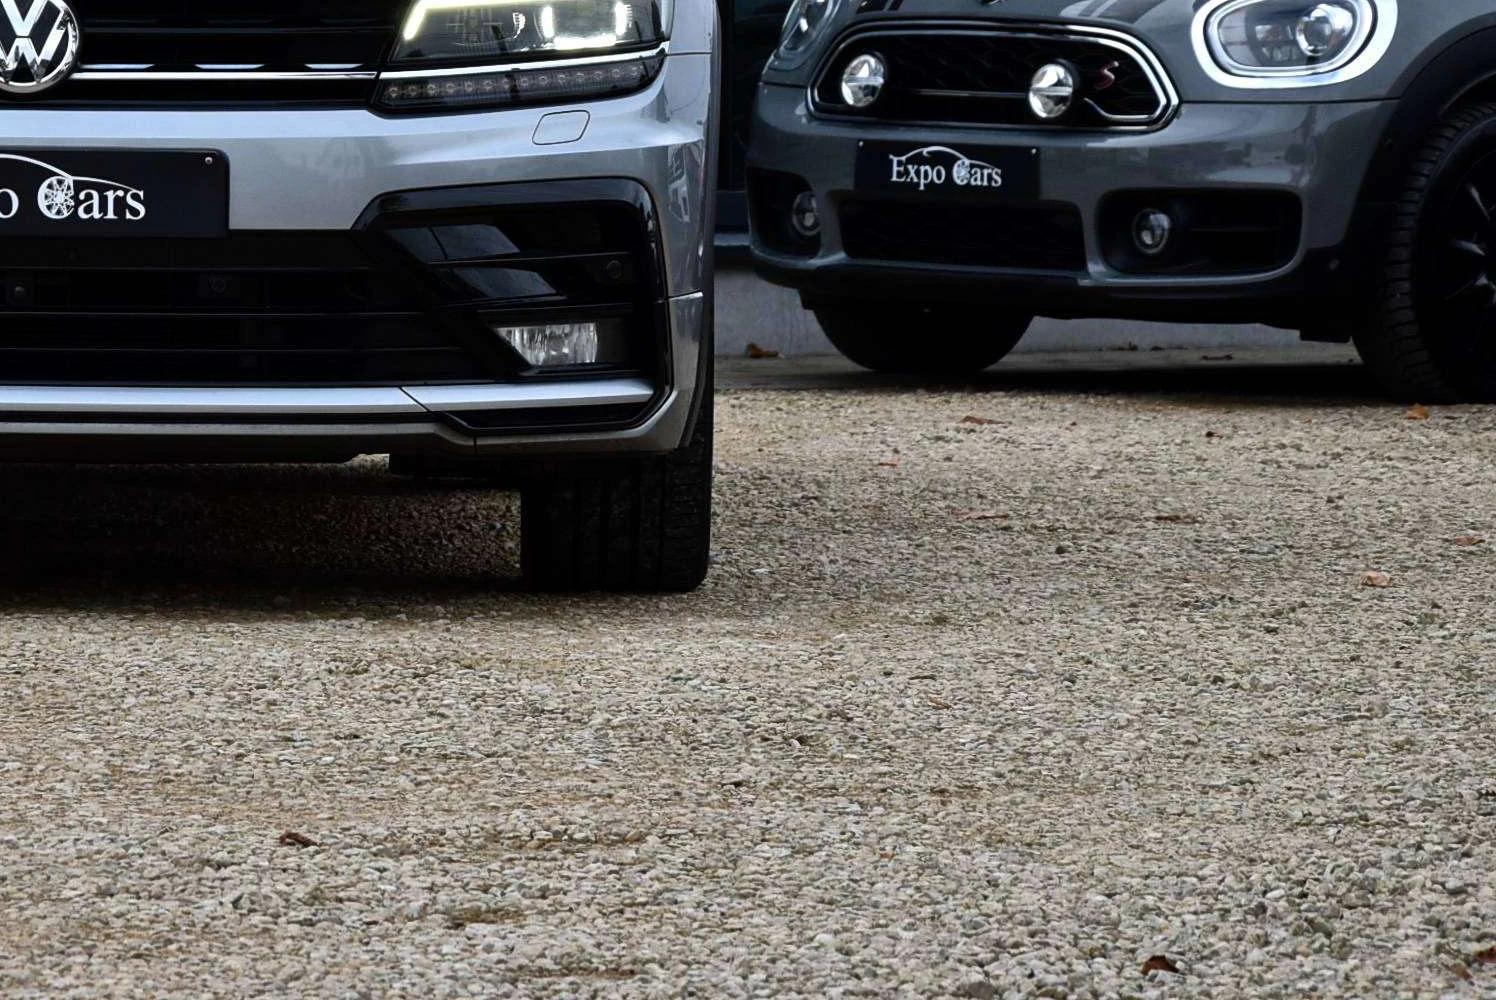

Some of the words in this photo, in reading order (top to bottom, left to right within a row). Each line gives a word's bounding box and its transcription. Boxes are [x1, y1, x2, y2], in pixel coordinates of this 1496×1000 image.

[888, 154, 946, 191] Expo
[952, 159, 1003, 188] Cars
[37, 175, 147, 221] Cars
